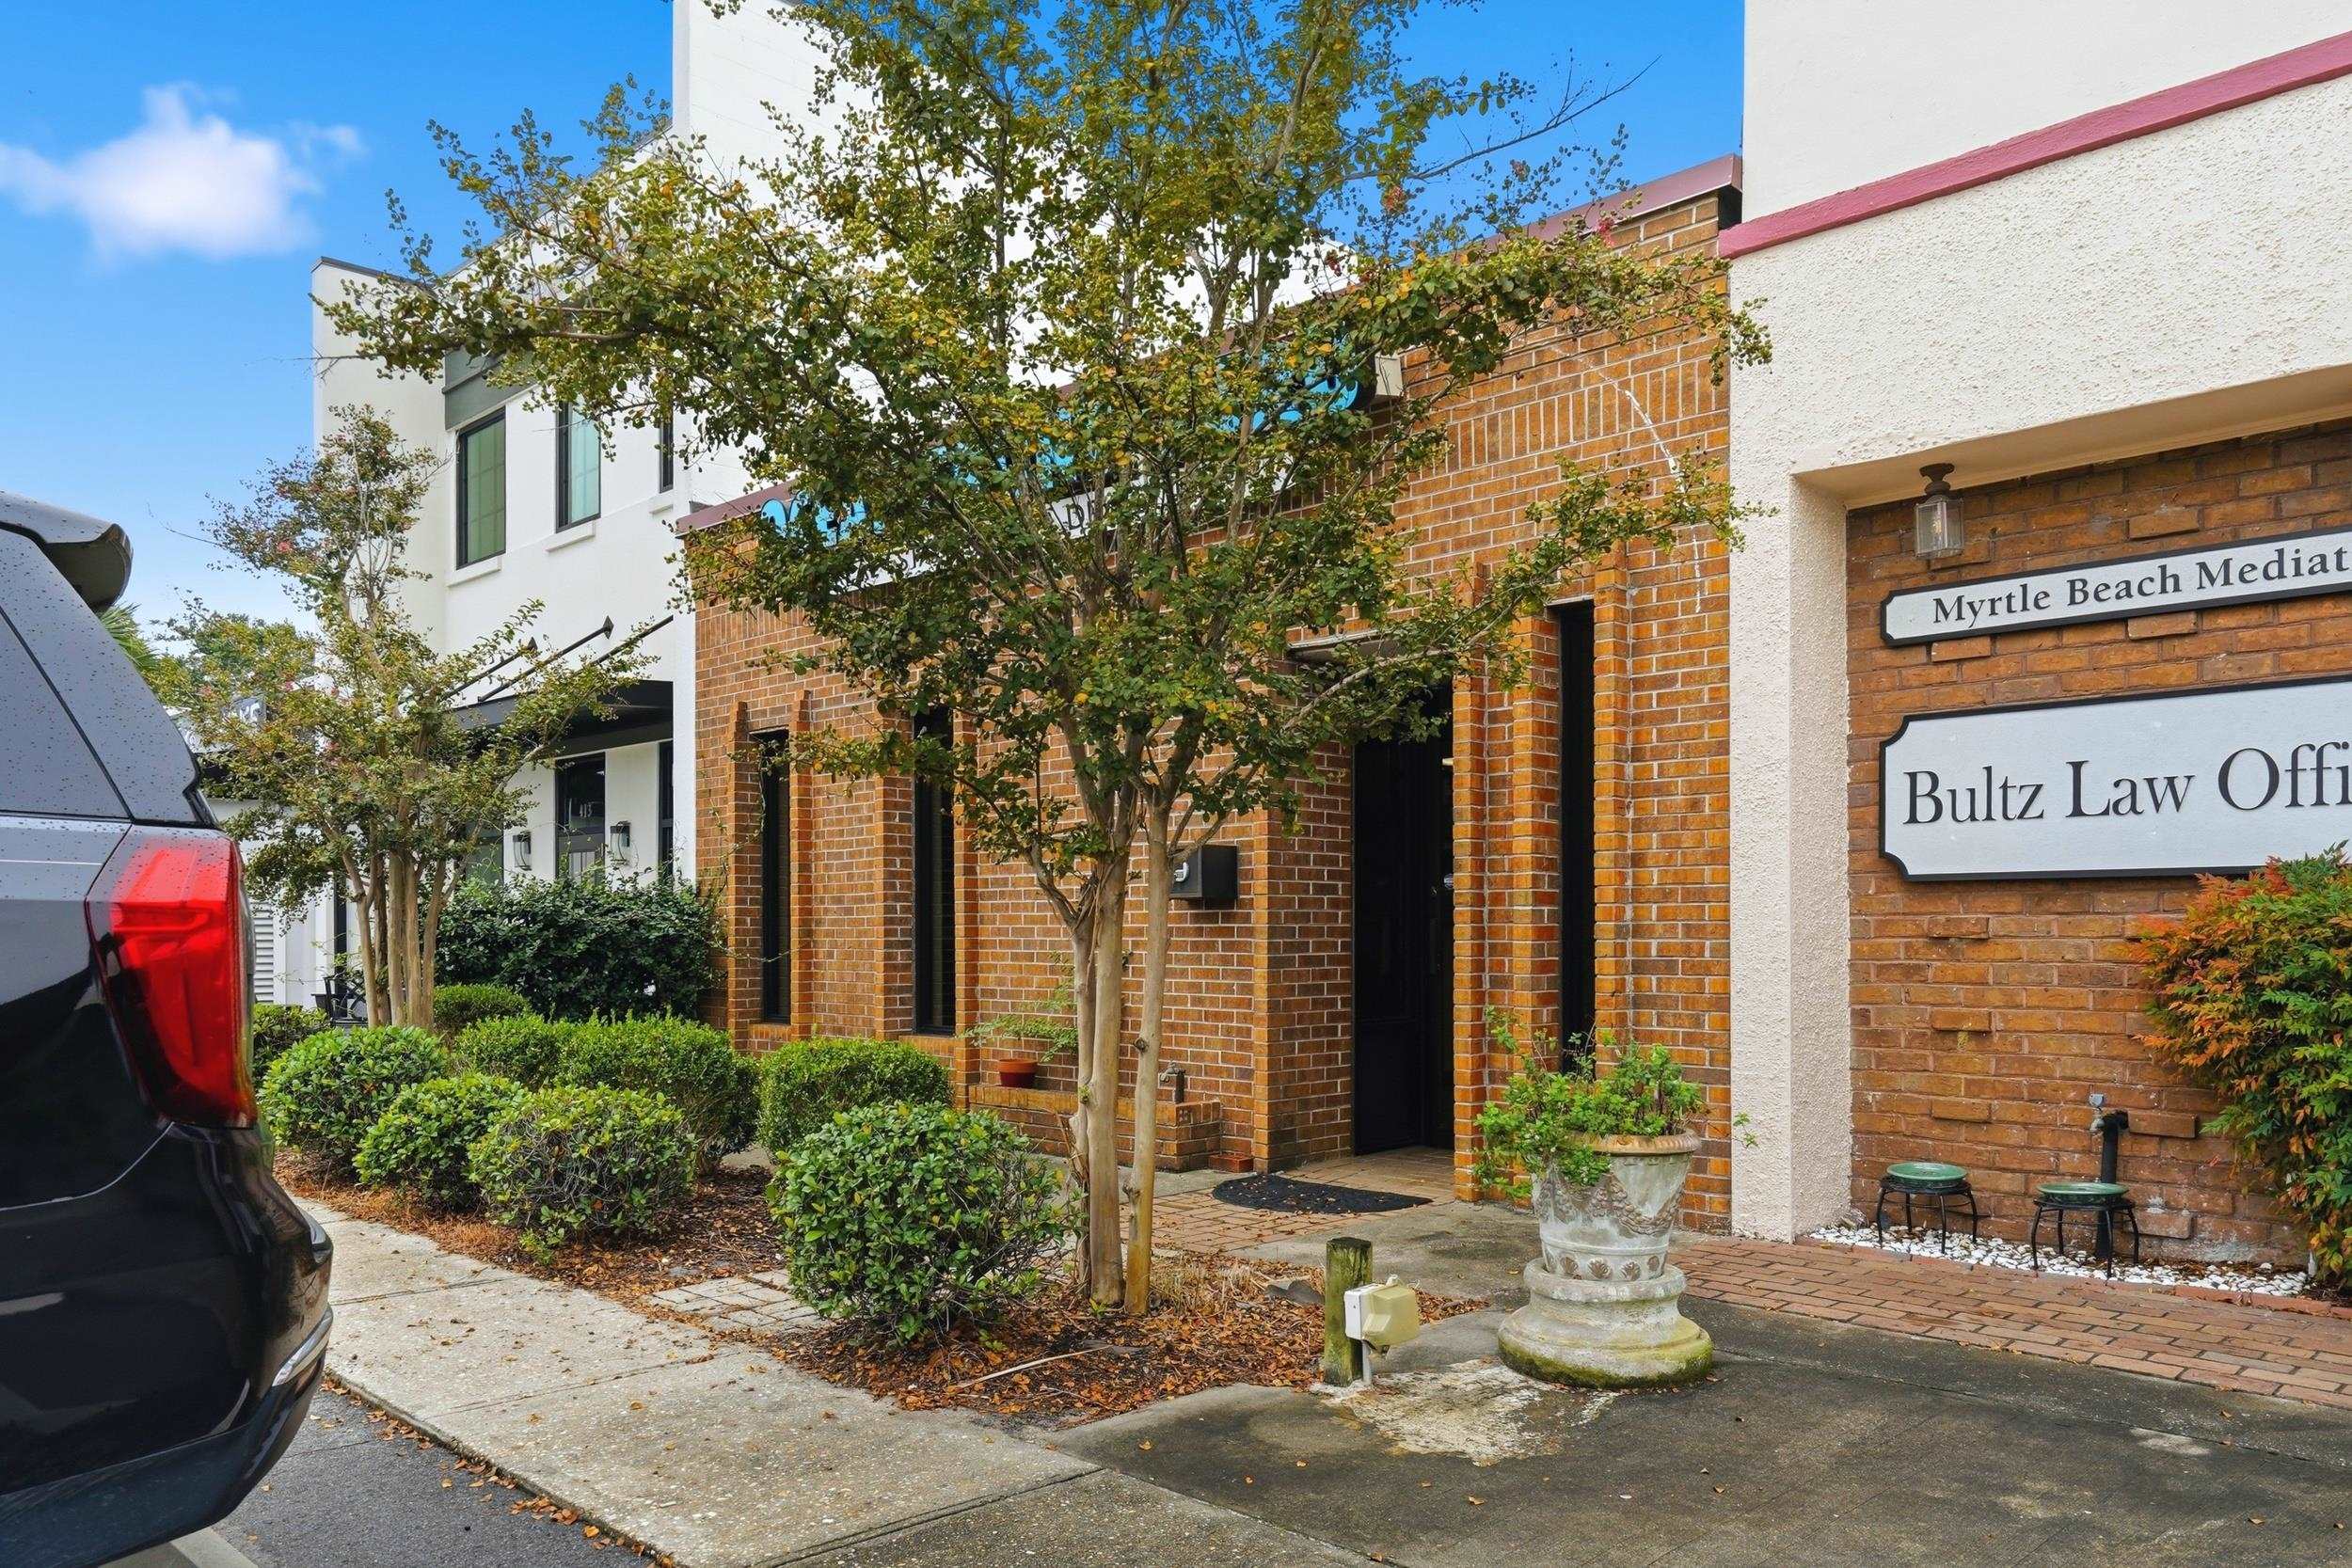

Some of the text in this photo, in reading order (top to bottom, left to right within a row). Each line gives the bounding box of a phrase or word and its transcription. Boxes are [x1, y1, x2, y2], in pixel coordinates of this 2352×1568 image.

[1932, 546, 2351, 628] Myrtle Beach Mediat
[1902, 740, 2352, 825] Bultz Law Offi
